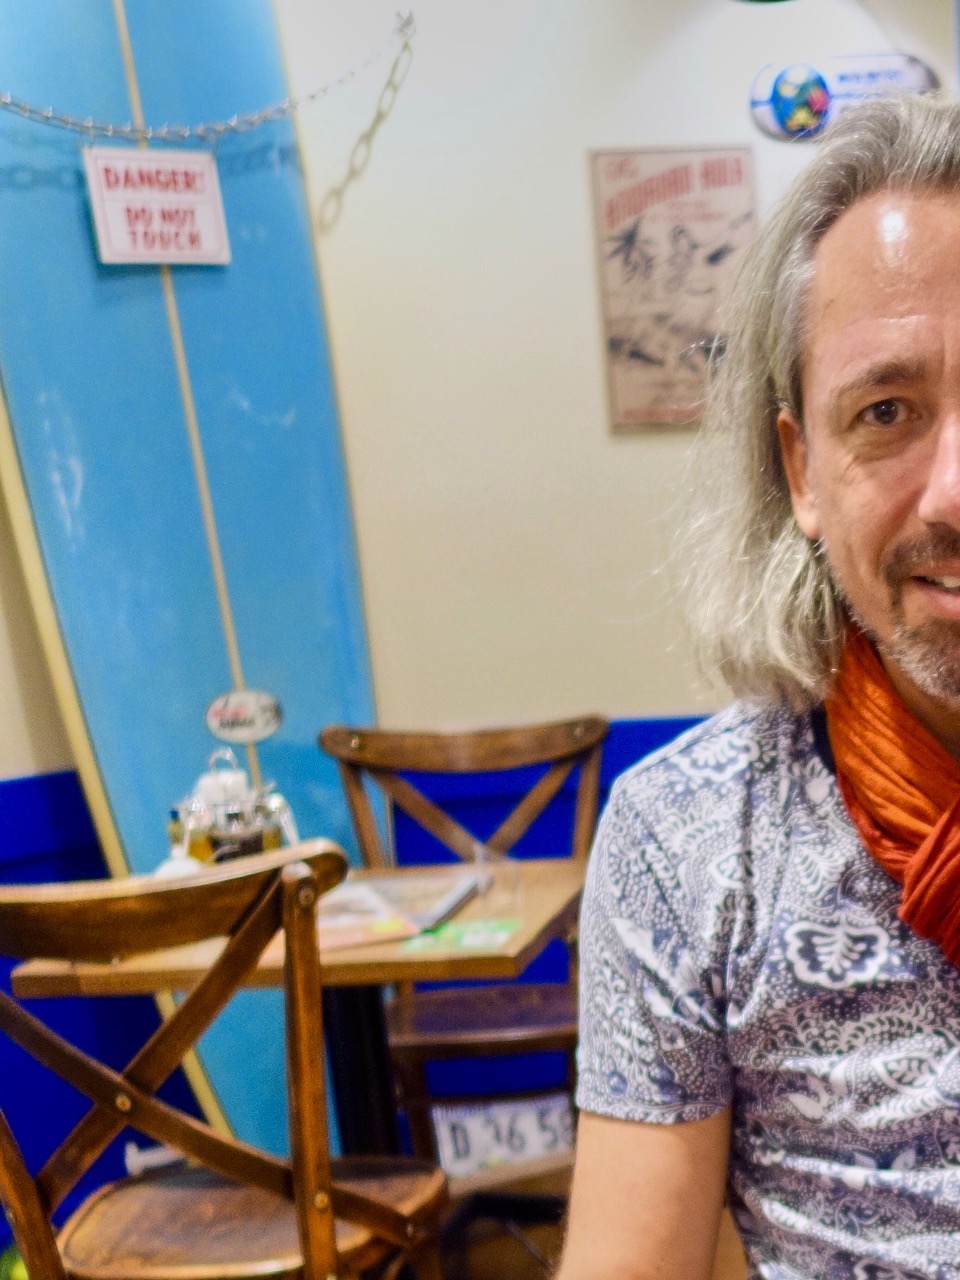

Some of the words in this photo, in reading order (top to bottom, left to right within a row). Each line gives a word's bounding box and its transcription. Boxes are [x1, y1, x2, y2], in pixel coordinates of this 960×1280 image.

[125, 206, 152, 229] DO
[160, 208, 195, 230] NOT
[128, 230, 202, 250] TOUCH
